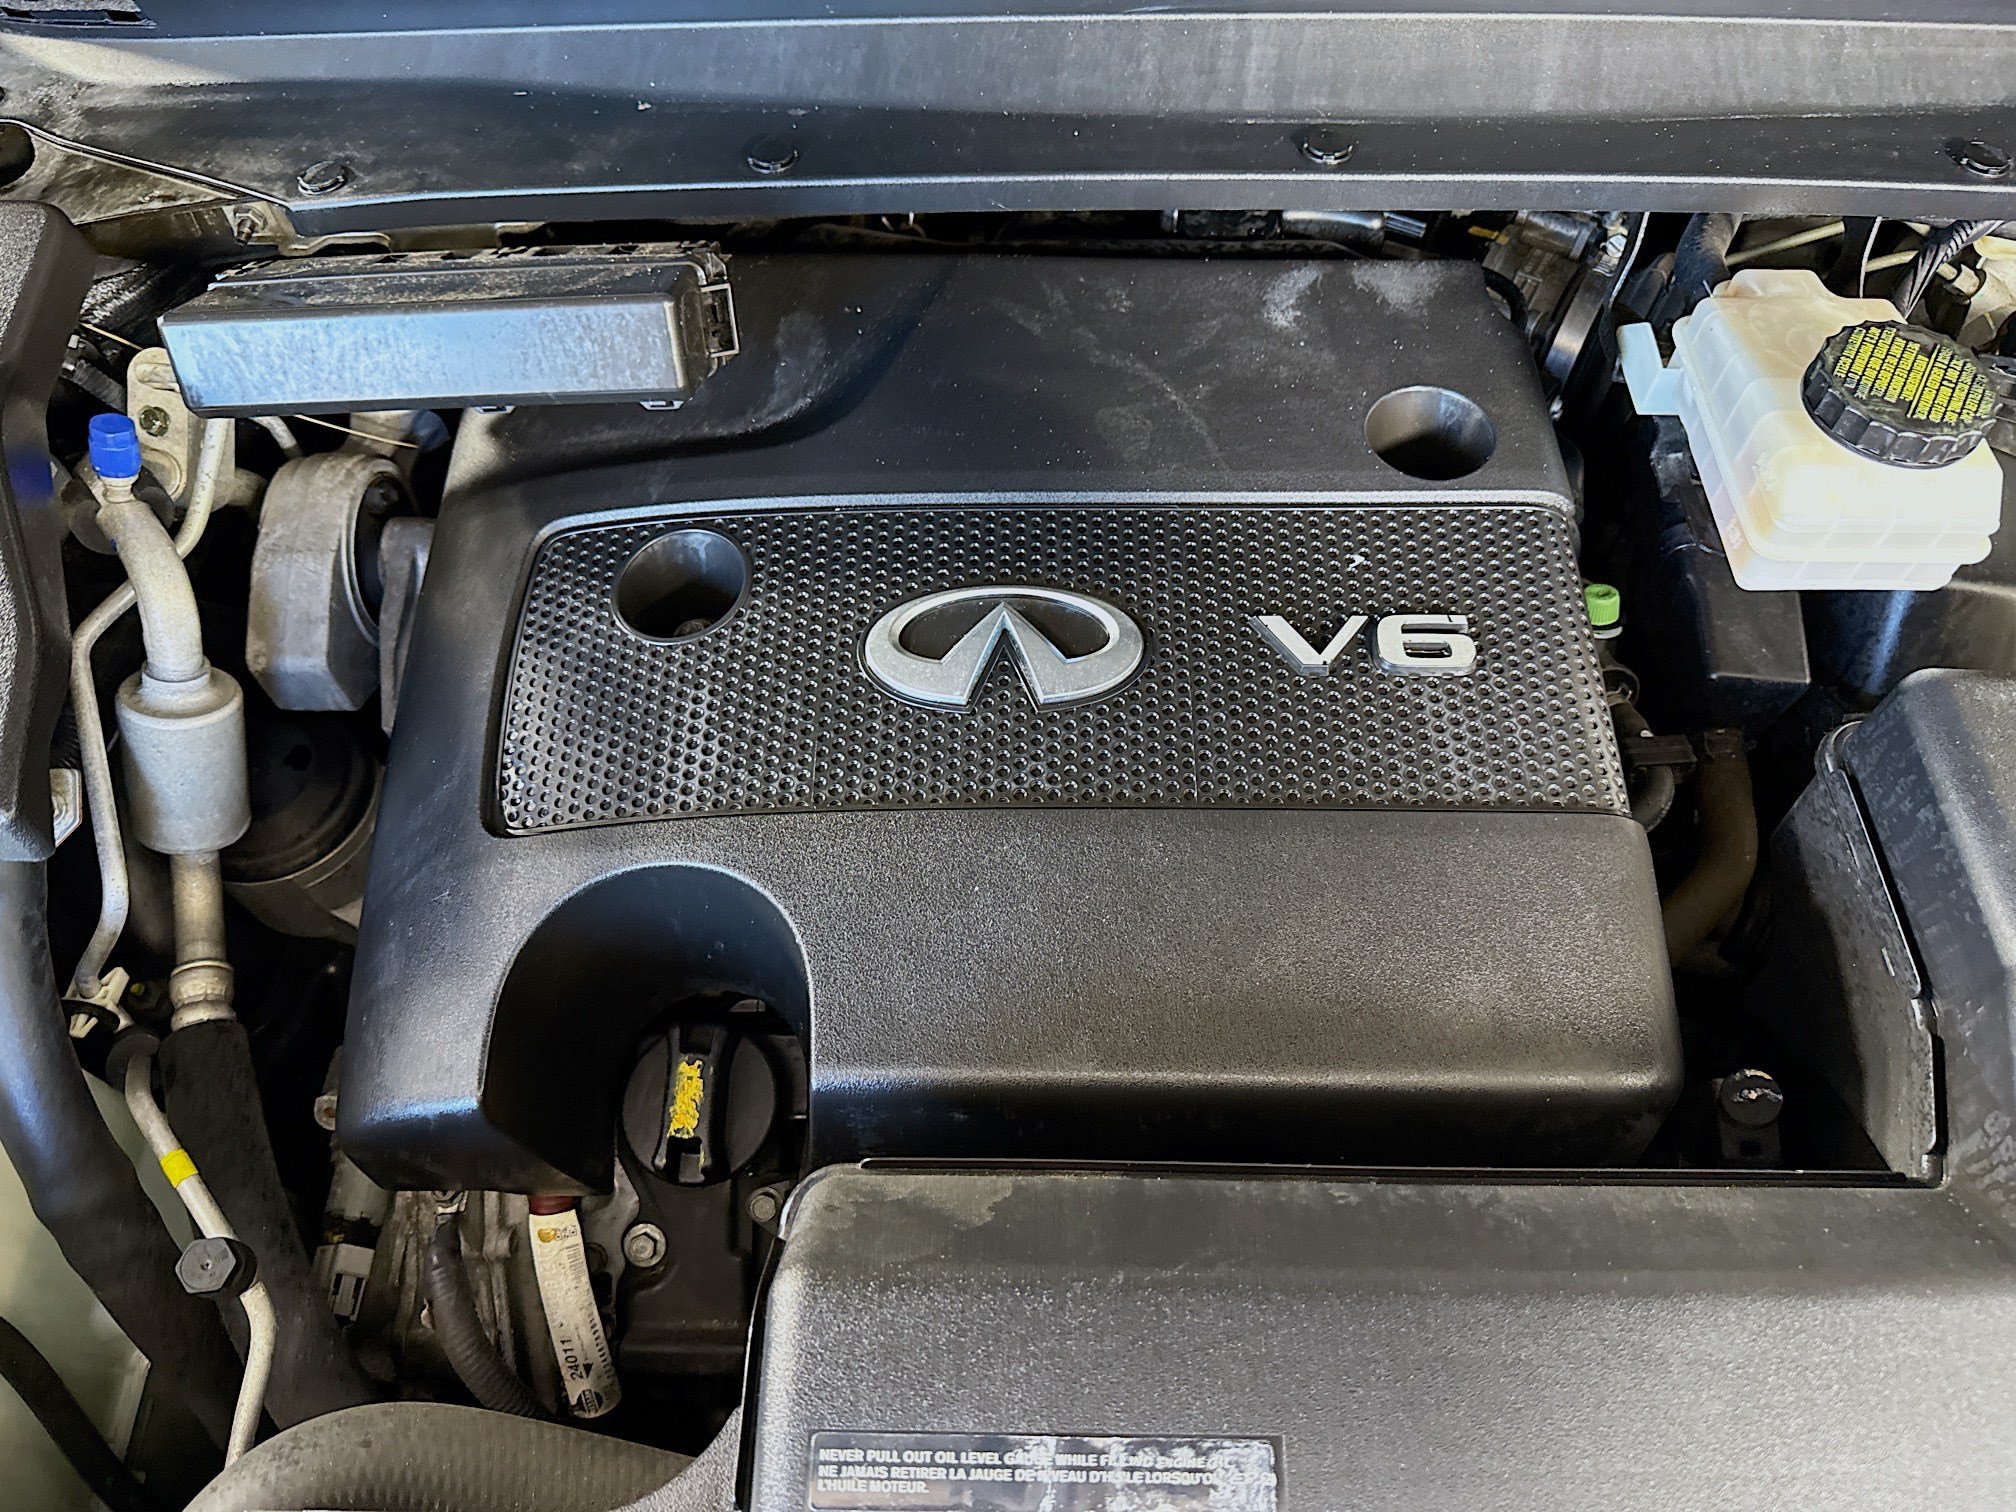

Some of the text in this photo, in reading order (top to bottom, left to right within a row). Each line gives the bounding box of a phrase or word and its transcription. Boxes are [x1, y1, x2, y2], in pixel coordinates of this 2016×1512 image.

[1250, 614, 1477, 677] V6
[560, 1338, 584, 1380] 24011
[819, 1448, 865, 1463] NEVER
[866, 1450, 900, 1463] PULL
[903, 1450, 933, 1463] OUT
[934, 1451, 959, 1464] OIL
[961, 1451, 1003, 1465] LEVEL
[1055, 1453, 1098, 1467] WHILE
[818, 1465, 839, 1478] NE
[840, 1465, 888, 1479] JAMAIS
[890, 1466, 946, 1480] RETIRER
[949, 1468, 968, 1480] LA
[968, 1469, 1014, 1482] JAUGE
[817, 1479, 930, 1494] L'HUILE MOTEUR.
